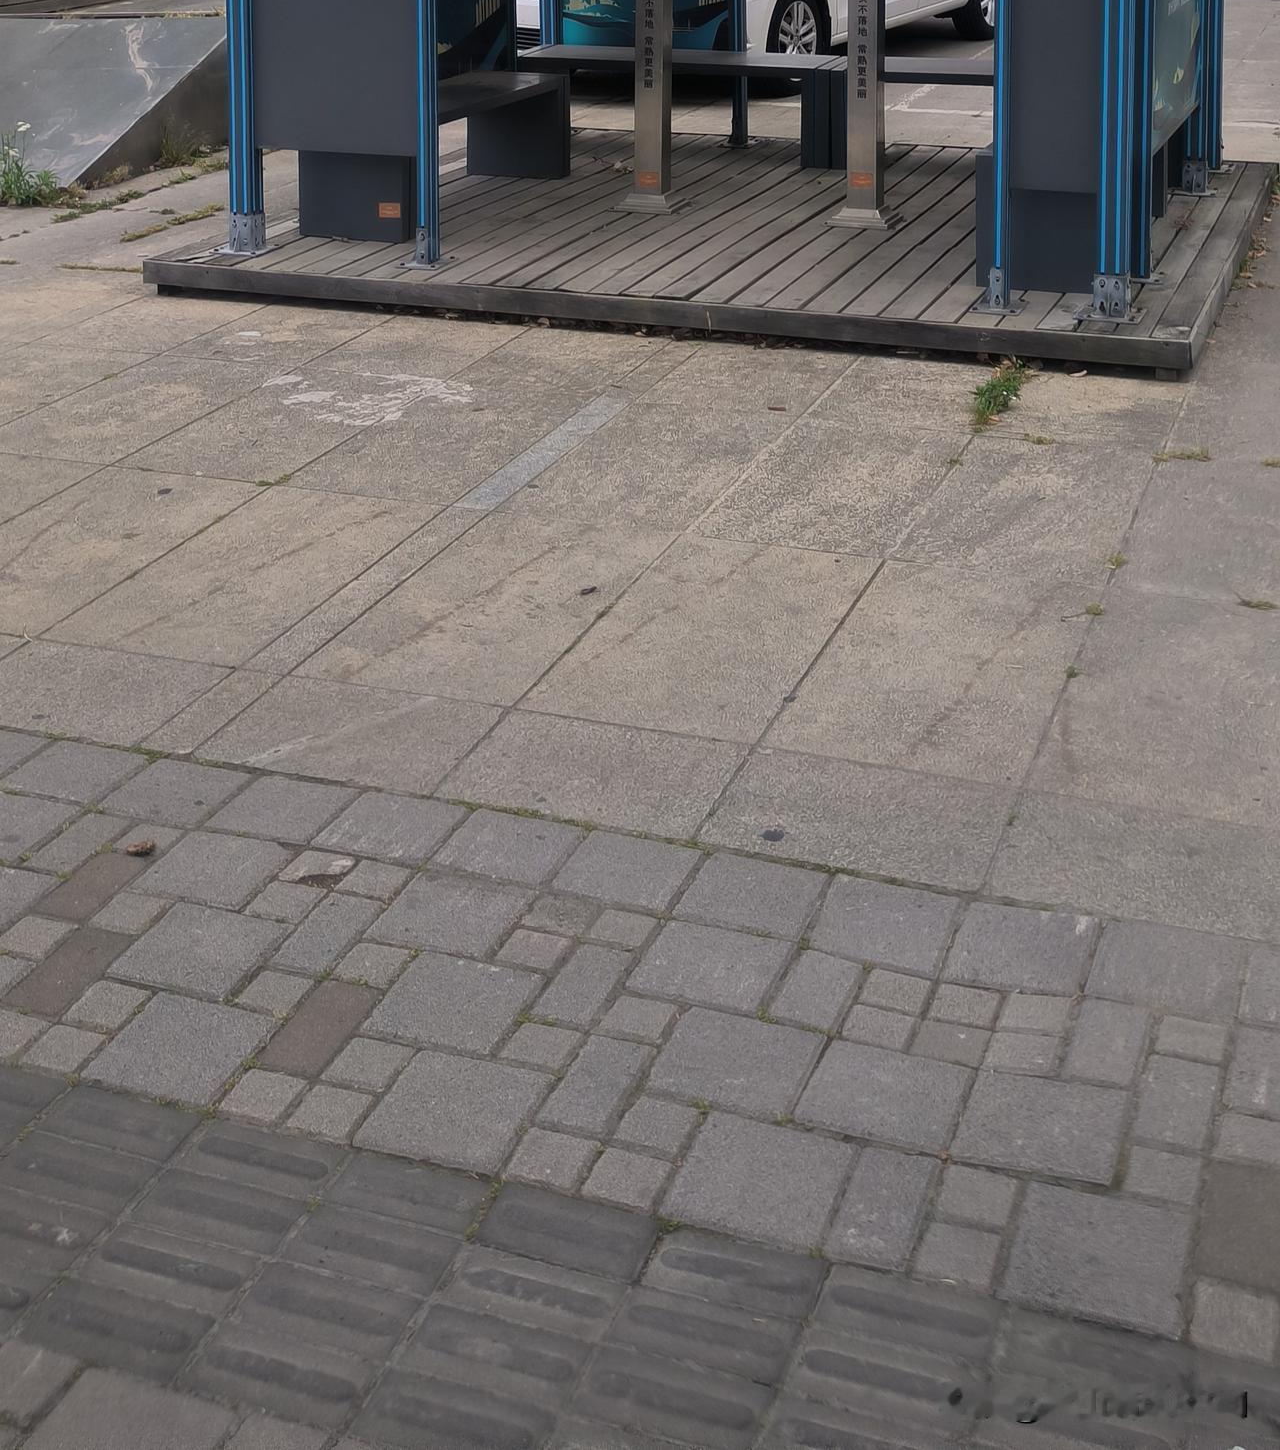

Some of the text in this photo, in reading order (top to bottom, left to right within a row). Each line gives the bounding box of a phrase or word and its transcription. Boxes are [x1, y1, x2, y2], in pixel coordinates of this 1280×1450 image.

[644, 36, 654, 89] 常熟更美丽
[857, 44, 867, 99] 常熟更美丽
